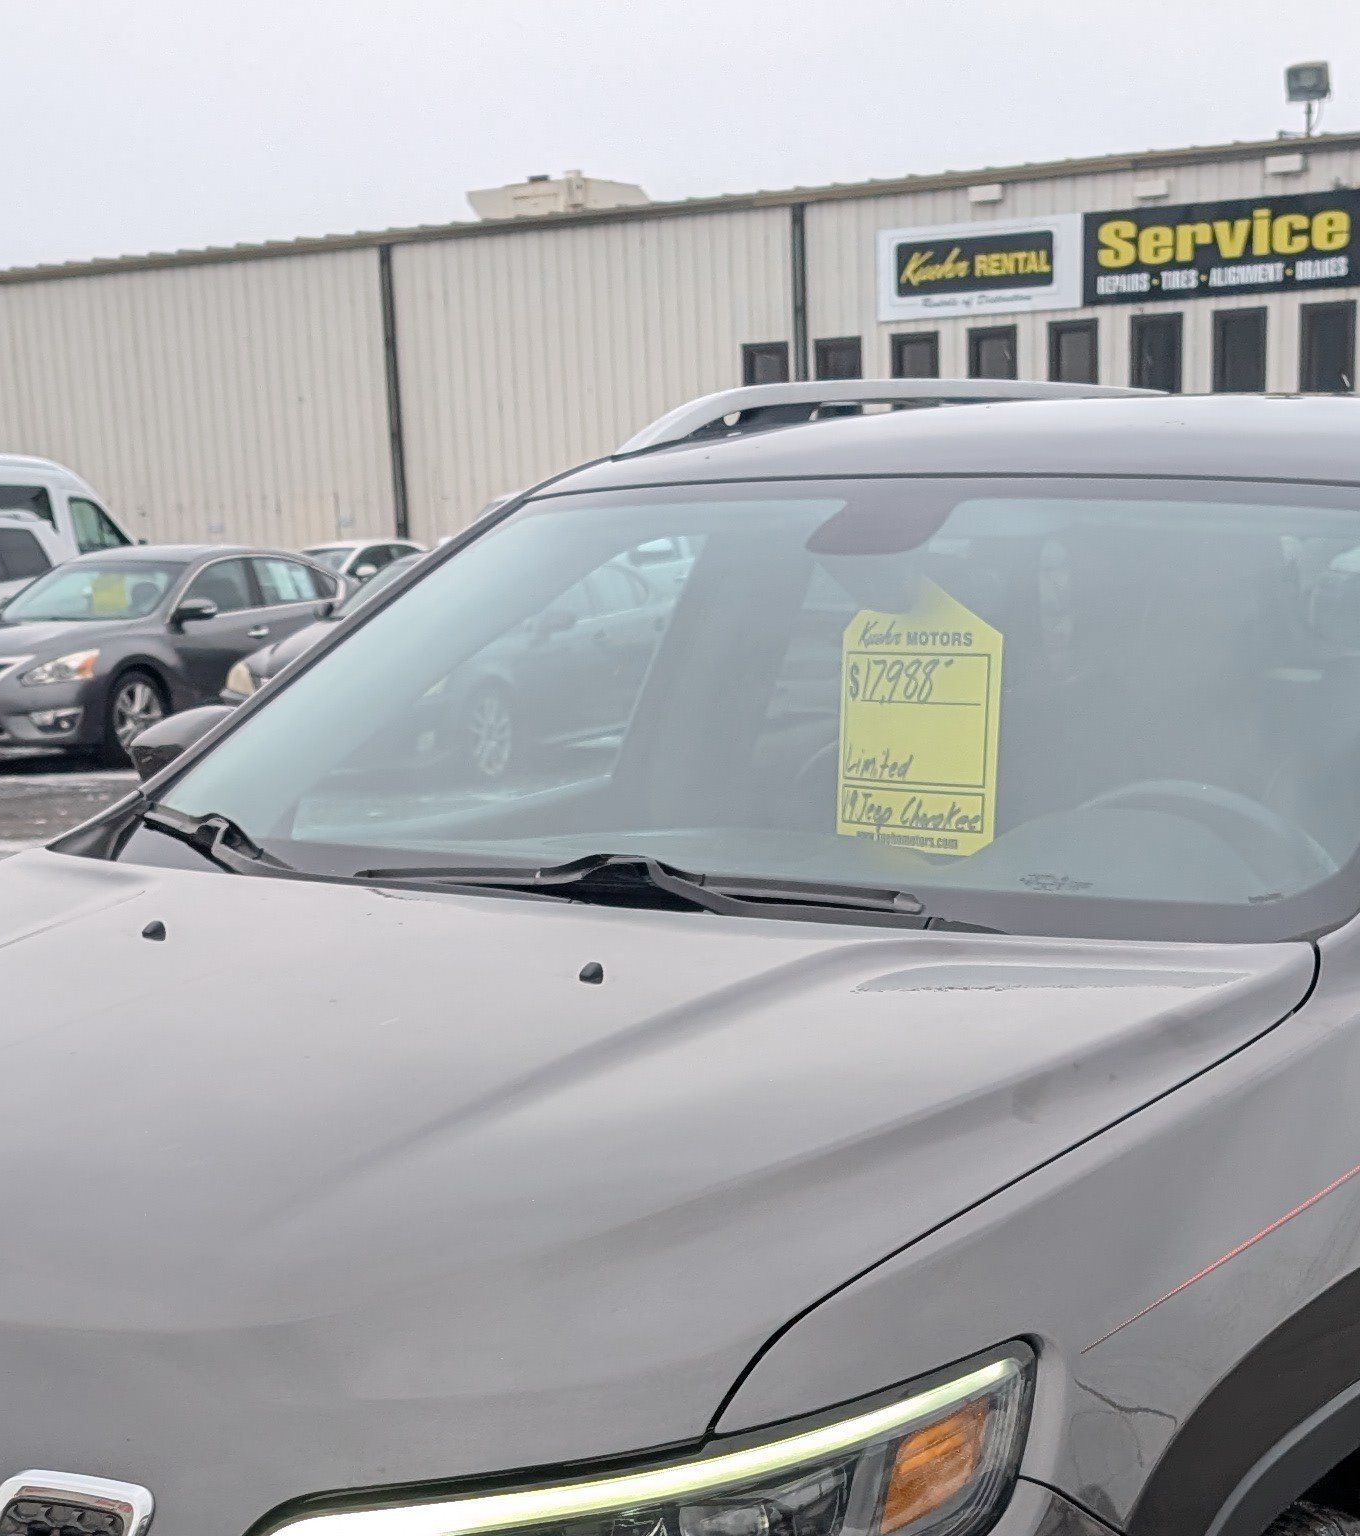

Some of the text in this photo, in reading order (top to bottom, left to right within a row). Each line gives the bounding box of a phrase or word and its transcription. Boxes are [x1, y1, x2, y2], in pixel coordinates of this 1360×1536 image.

[1097, 208, 1351, 268] Service
[974, 250, 1050, 277] RENTAL
[1097, 257, 1348, 295] REPAIRS TIRES ALIGNMENT BRAKES
[906, 632, 973, 647] MOTORS
[846, 743, 914, 779] Limited
[857, 793, 893, 833] Jeep
[900, 796, 981, 832] Cherokee
